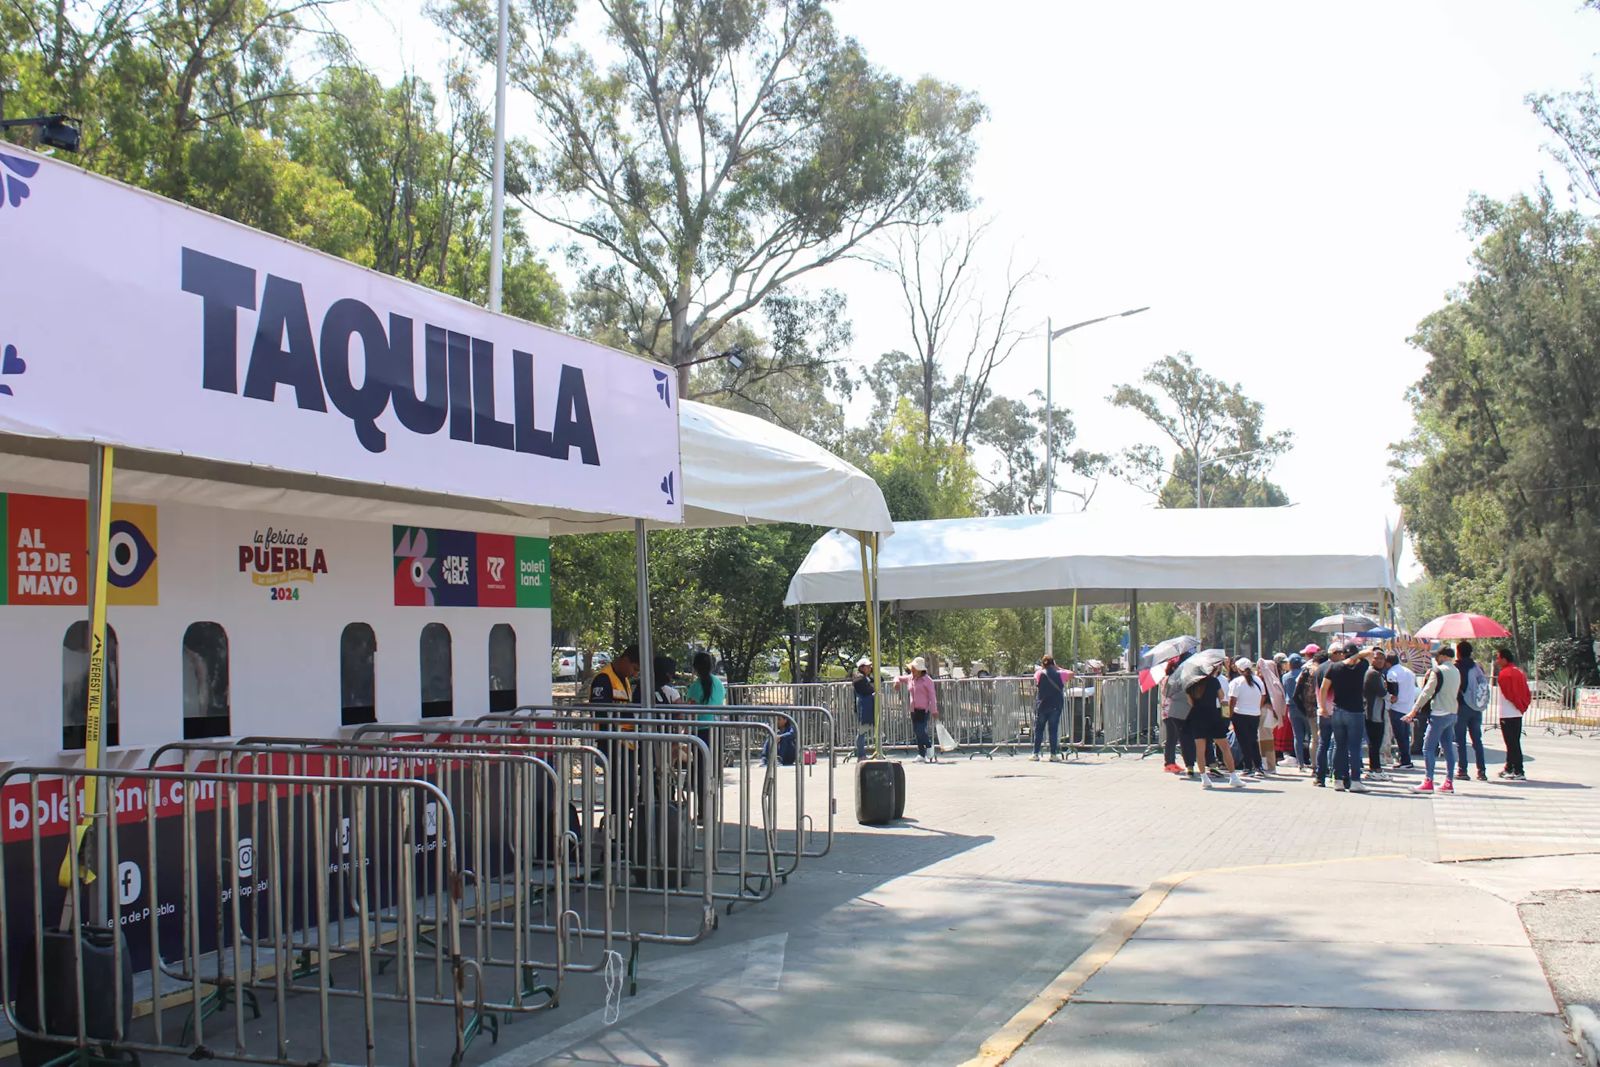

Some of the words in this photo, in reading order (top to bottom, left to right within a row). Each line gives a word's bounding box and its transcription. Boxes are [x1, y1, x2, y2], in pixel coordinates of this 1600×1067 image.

[181, 246, 601, 467] TAQUILLA
[17, 527, 46, 549] AL
[253, 530, 264, 543] la
[264, 527, 296, 550] feria
[297, 533, 308, 546] de
[17, 551, 42, 572] 12
[45, 552, 71, 573] DE
[238, 545, 328, 574] PUEBLA
[451, 556, 469, 571] PUE
[520, 559, 545, 573] boleti
[17, 574, 78, 596] MAYO
[451, 570, 469, 585] BLA
[270, 587, 300, 601] 2024
[89, 657, 102, 693] EVEREST
[88, 694, 100, 711] WLL
[128, 910, 141, 923] de
[142, 902, 175, 919] Pebla
